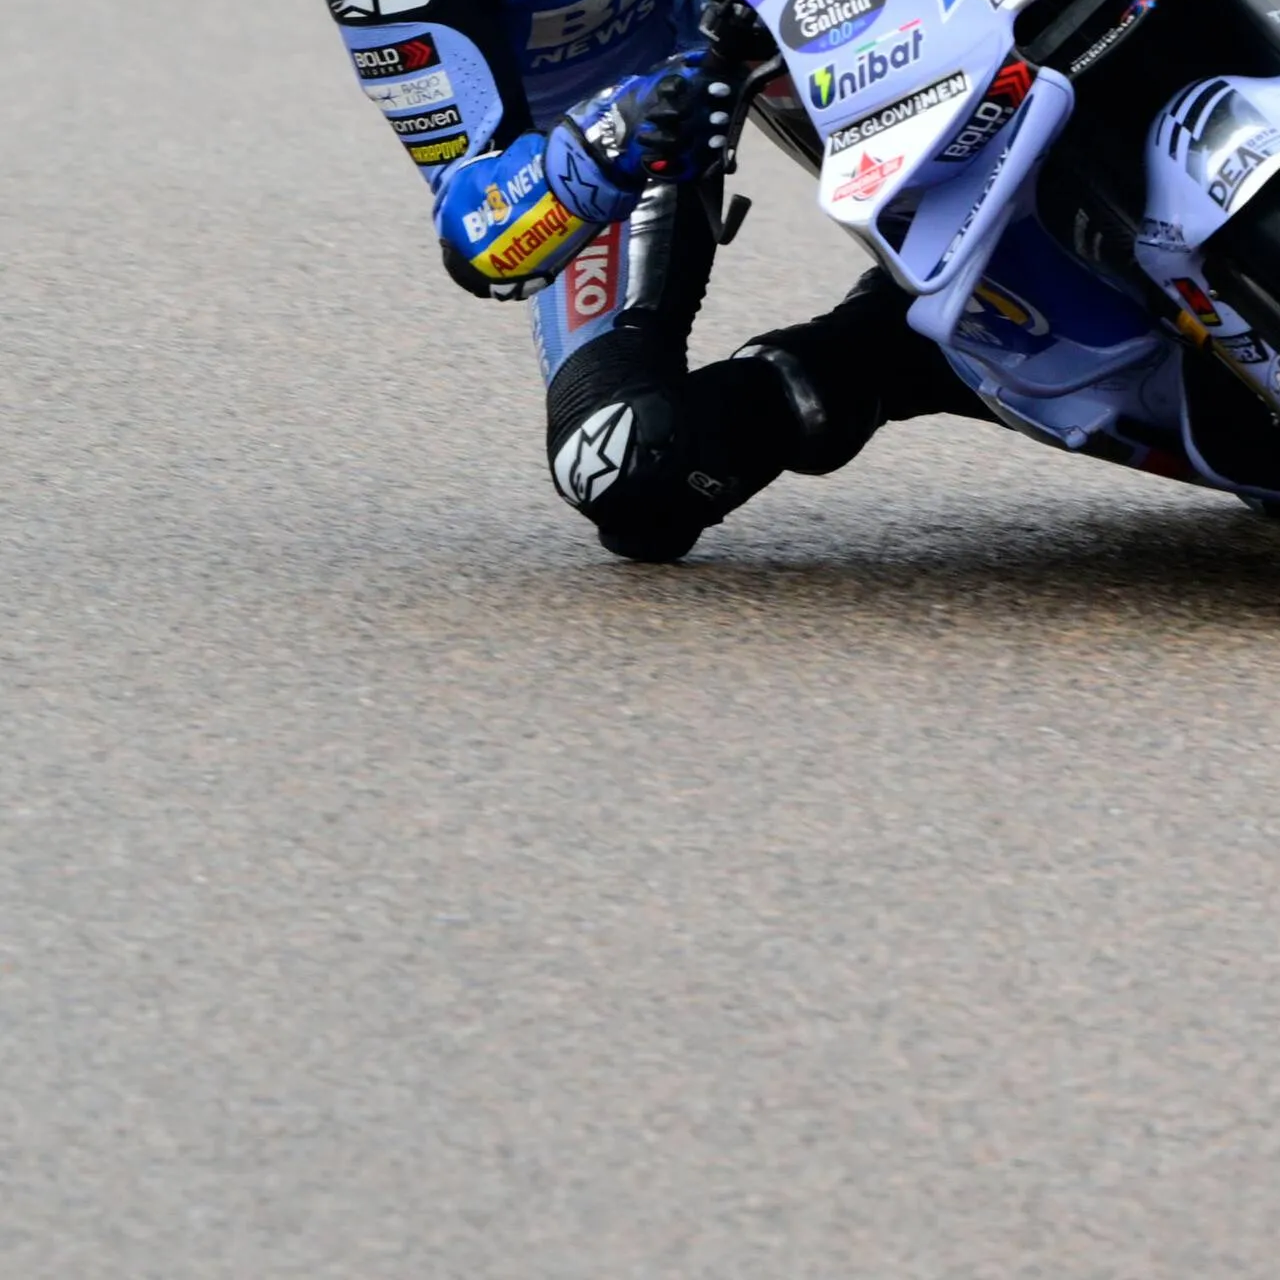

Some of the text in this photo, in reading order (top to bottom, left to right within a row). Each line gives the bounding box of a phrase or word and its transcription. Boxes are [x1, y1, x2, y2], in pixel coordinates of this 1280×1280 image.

[354, 47, 399, 68] BOLD
[809, 29, 924, 110] Unibat
[832, 74, 966, 151] MS GLOW MEN
[945, 101, 1001, 157] BOLD
[574, 220, 611, 316] IKO
